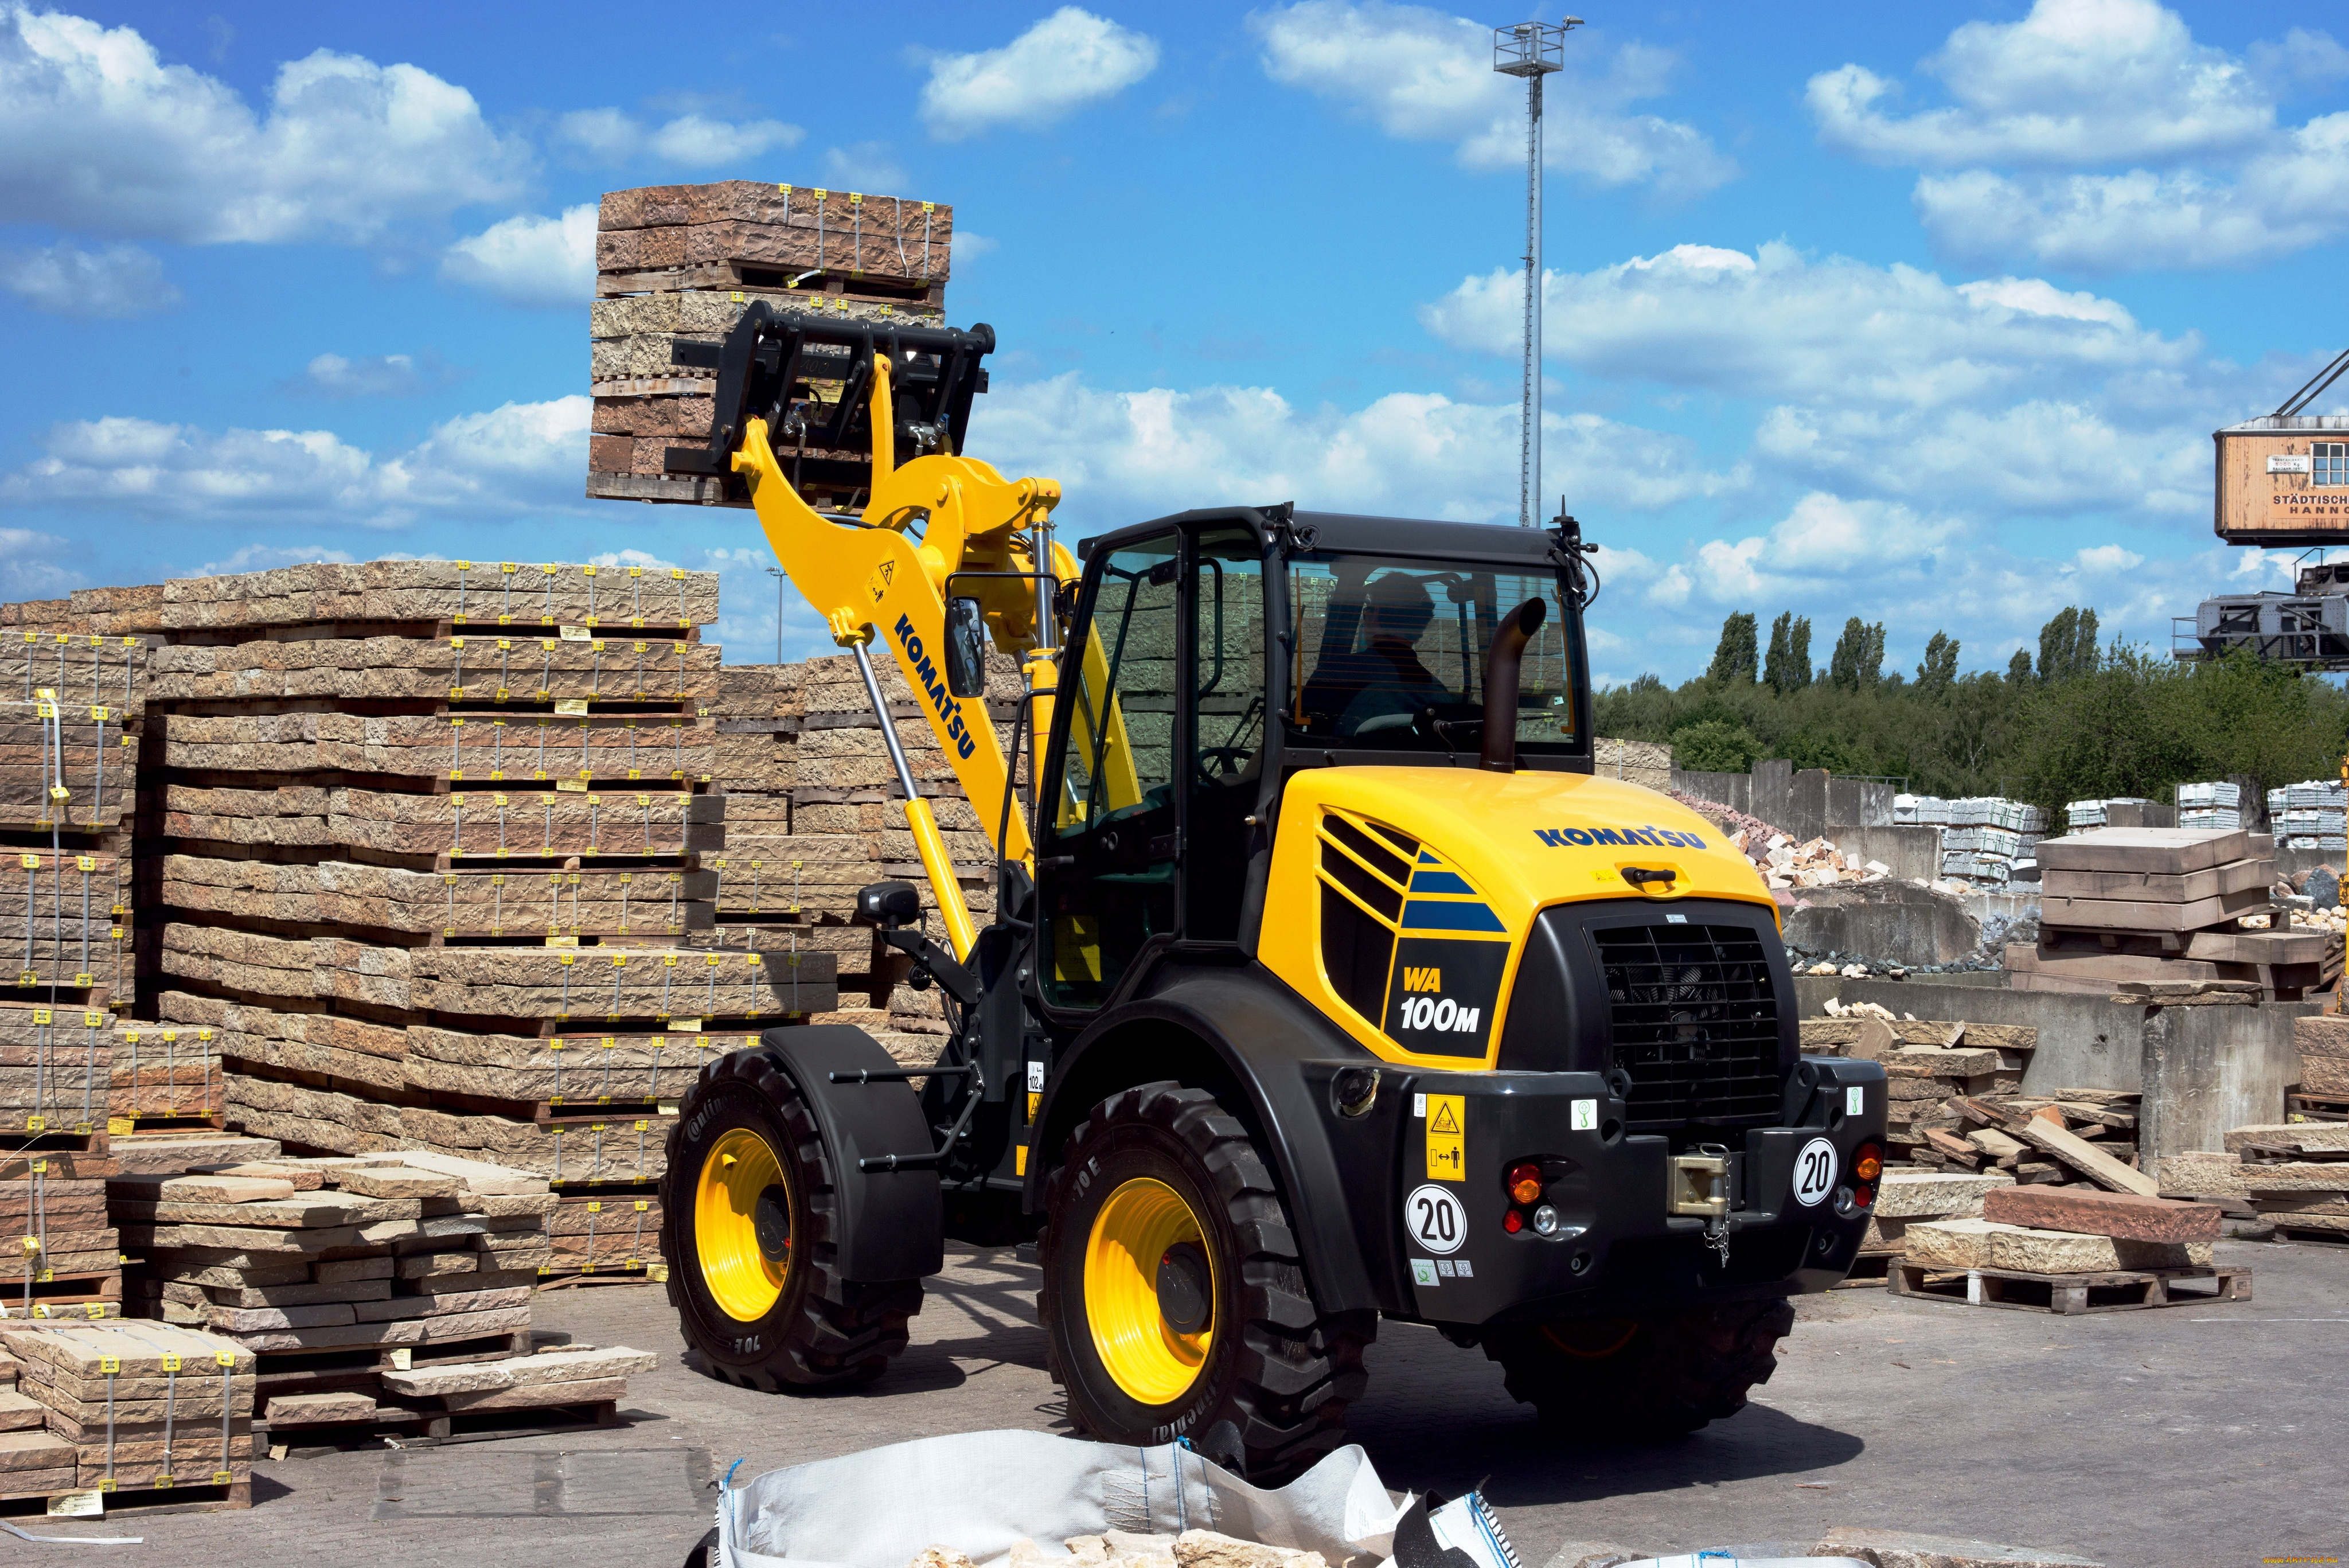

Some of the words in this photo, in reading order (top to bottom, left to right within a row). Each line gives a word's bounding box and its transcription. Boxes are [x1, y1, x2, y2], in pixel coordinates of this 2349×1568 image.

[2273, 493, 2349, 504] STÄDTISCH
[894, 613, 976, 759] KOMATSU
[1533, 825, 1707, 849] KOMATSU
[1404, 967, 1441, 993] WA
[1029, 1075, 1039, 1089] 102
[1801, 1150, 1830, 1194] 20
[1417, 1198, 1456, 1242] 20
